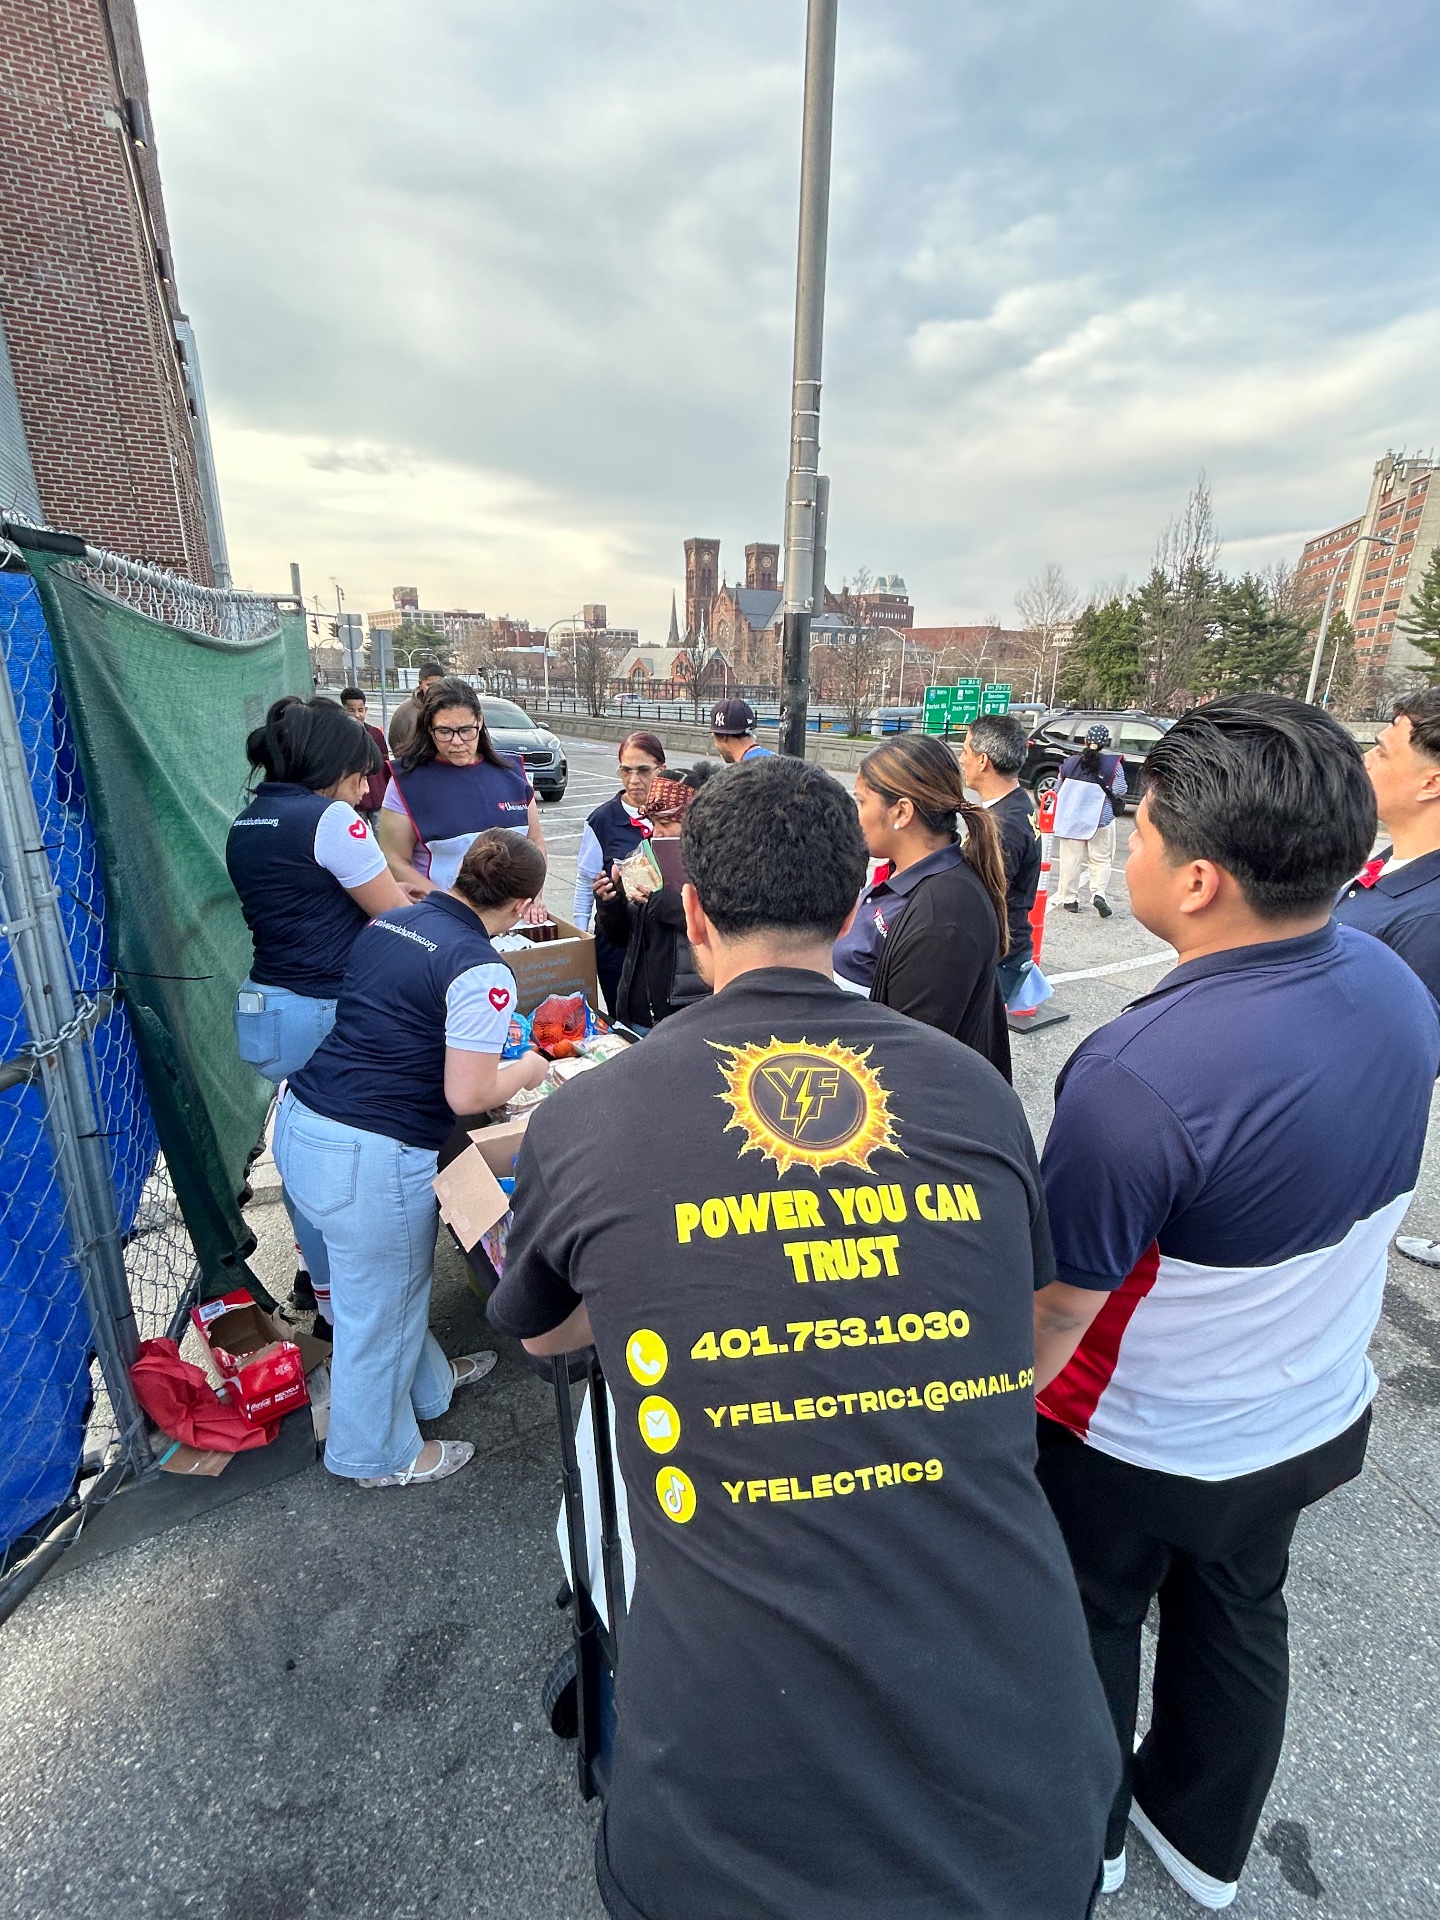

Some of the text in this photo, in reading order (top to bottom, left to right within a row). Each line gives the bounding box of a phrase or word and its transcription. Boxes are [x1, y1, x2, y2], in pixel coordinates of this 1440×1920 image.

[675, 1183, 981, 1244] POWER YOU CAN
[784, 1235, 900, 1284] TRUST
[690, 1310, 970, 1362] 401.753.1030
[704, 1367, 1034, 1429] YFELECTRIC1@GMAIL.CO
[721, 1458, 944, 1504] YFELECTRIC9
